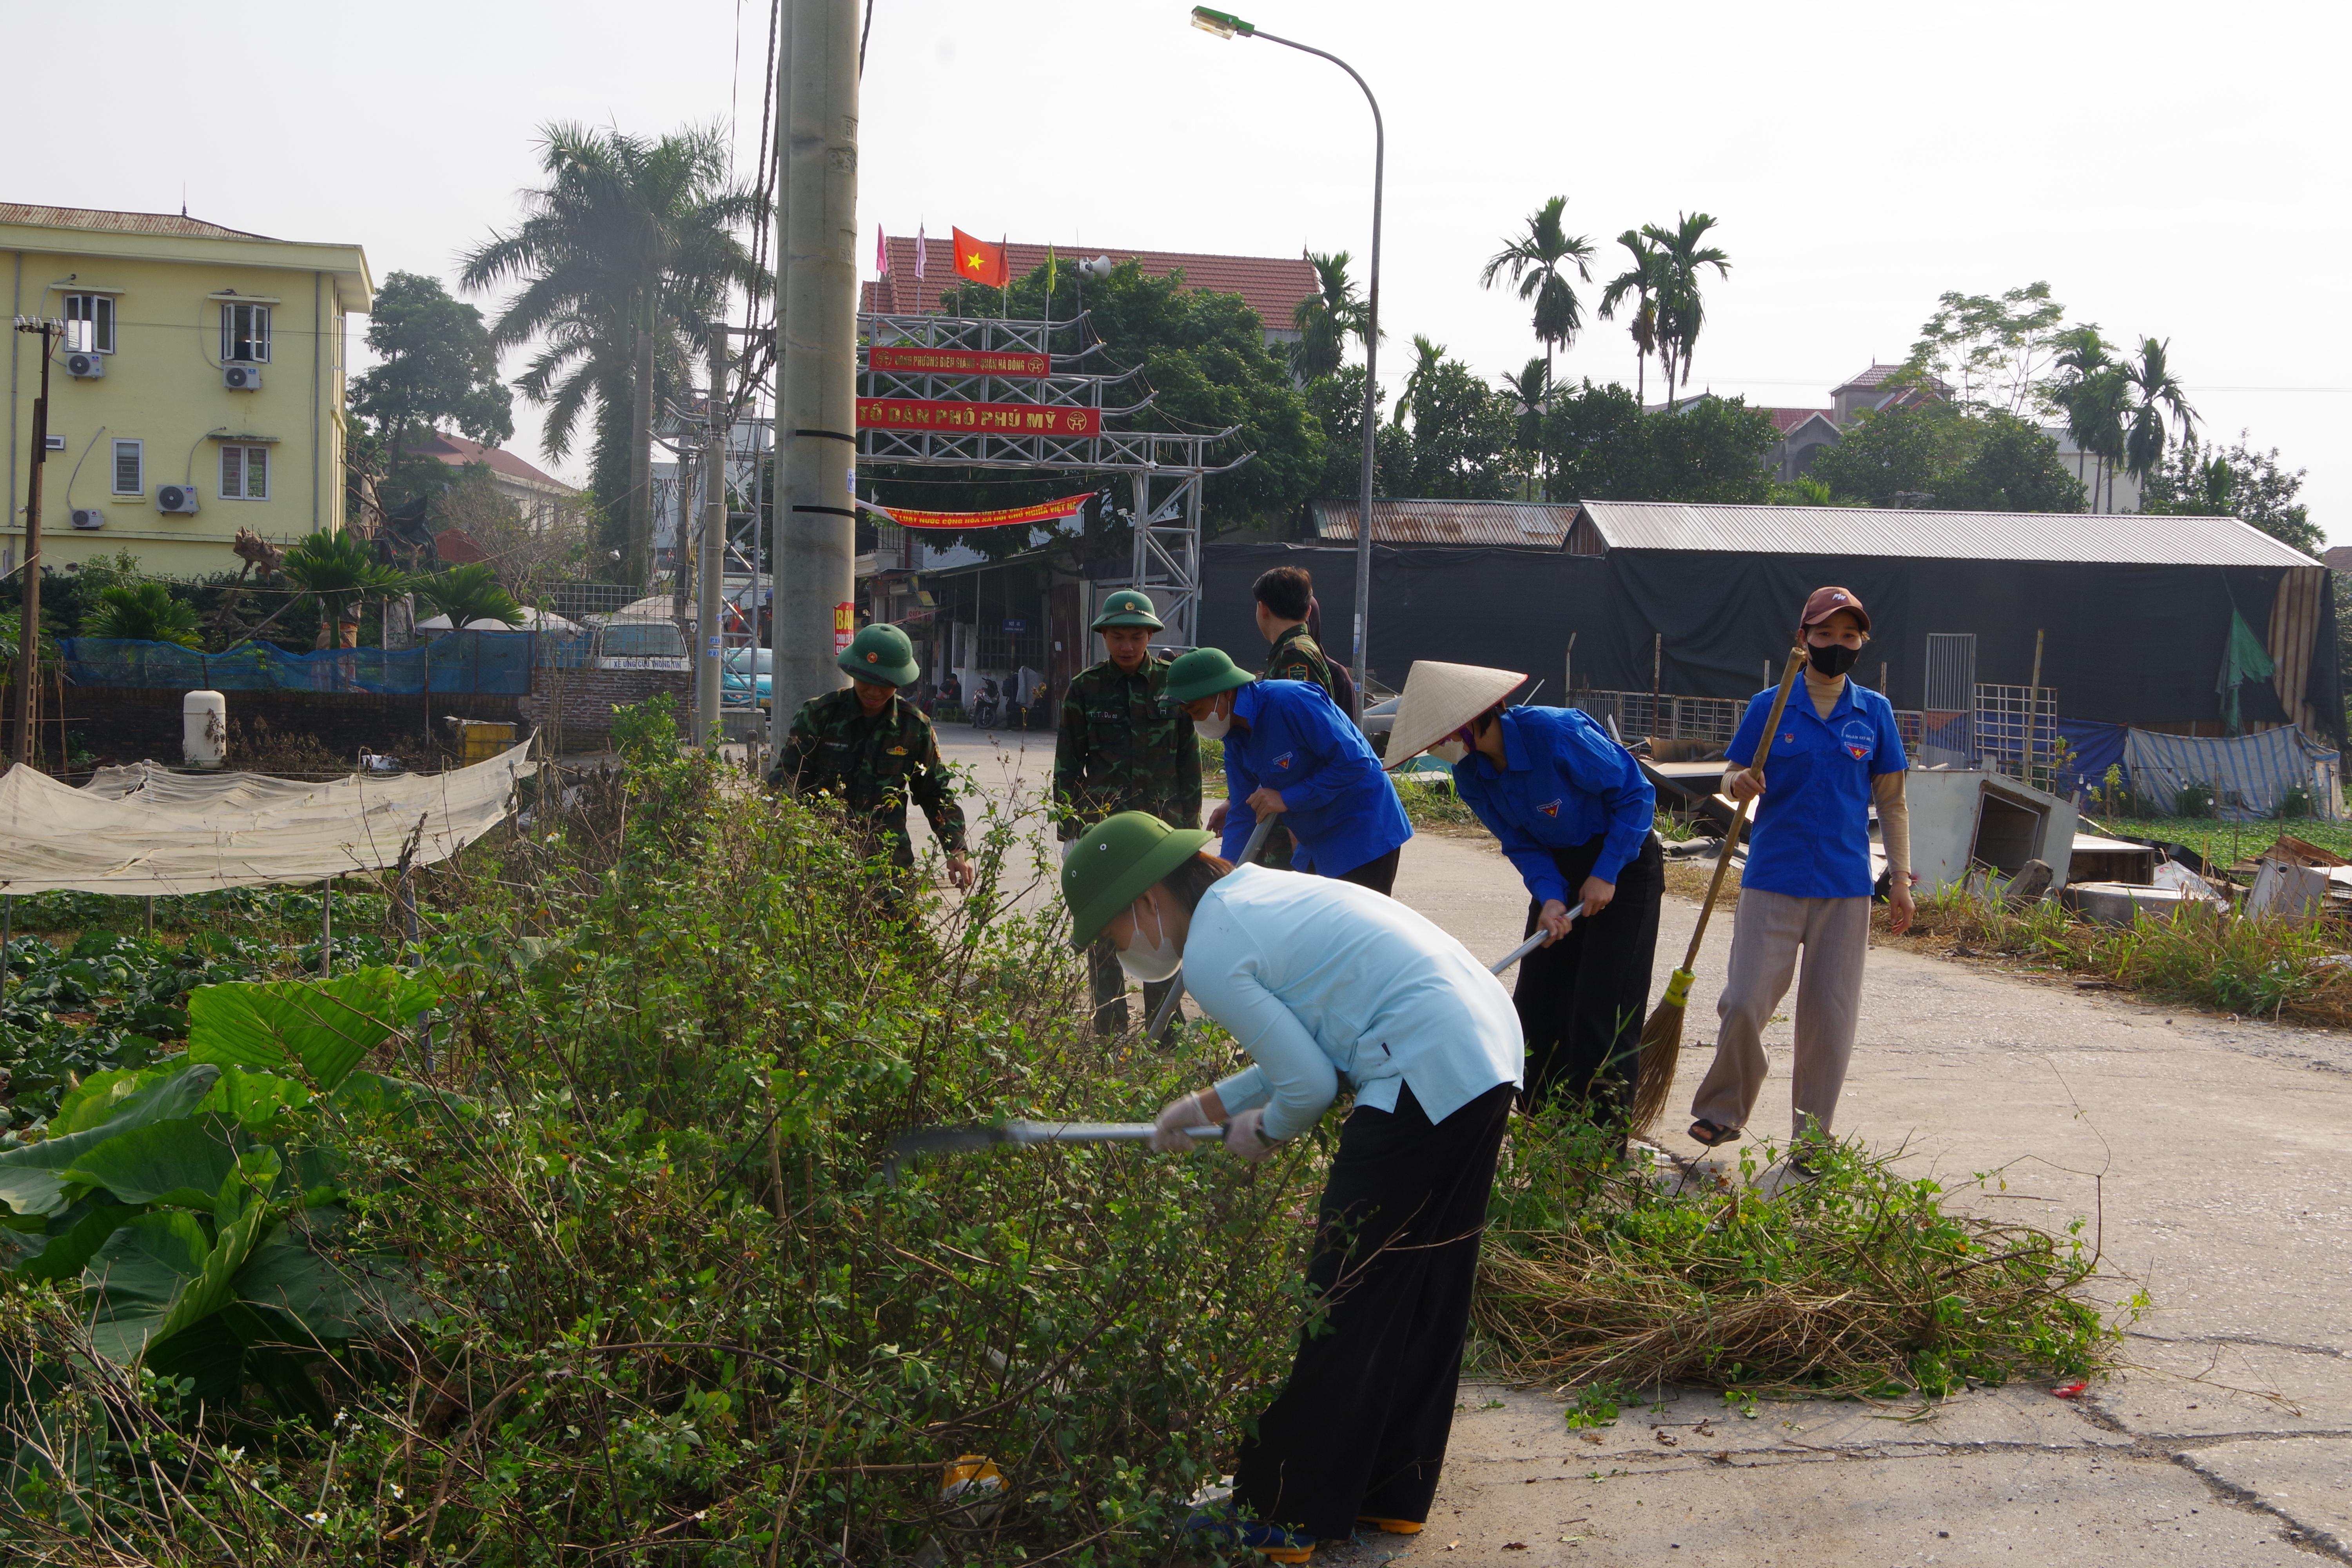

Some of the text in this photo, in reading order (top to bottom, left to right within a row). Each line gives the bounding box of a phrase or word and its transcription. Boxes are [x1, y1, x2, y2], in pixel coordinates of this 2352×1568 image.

[980, 356, 997, 372] QUẬN
[998, 357, 1006, 370] HÀ
[1007, 357, 1025, 371] ĐÔNG
[888, 405, 929, 423] DÂN
[936, 406, 976, 425] PHỐ
[981, 408, 1020, 427] PHÚ
[1026, 411, 1056, 429] MỸ
[1050, 504, 1065, 514] VIỆT
